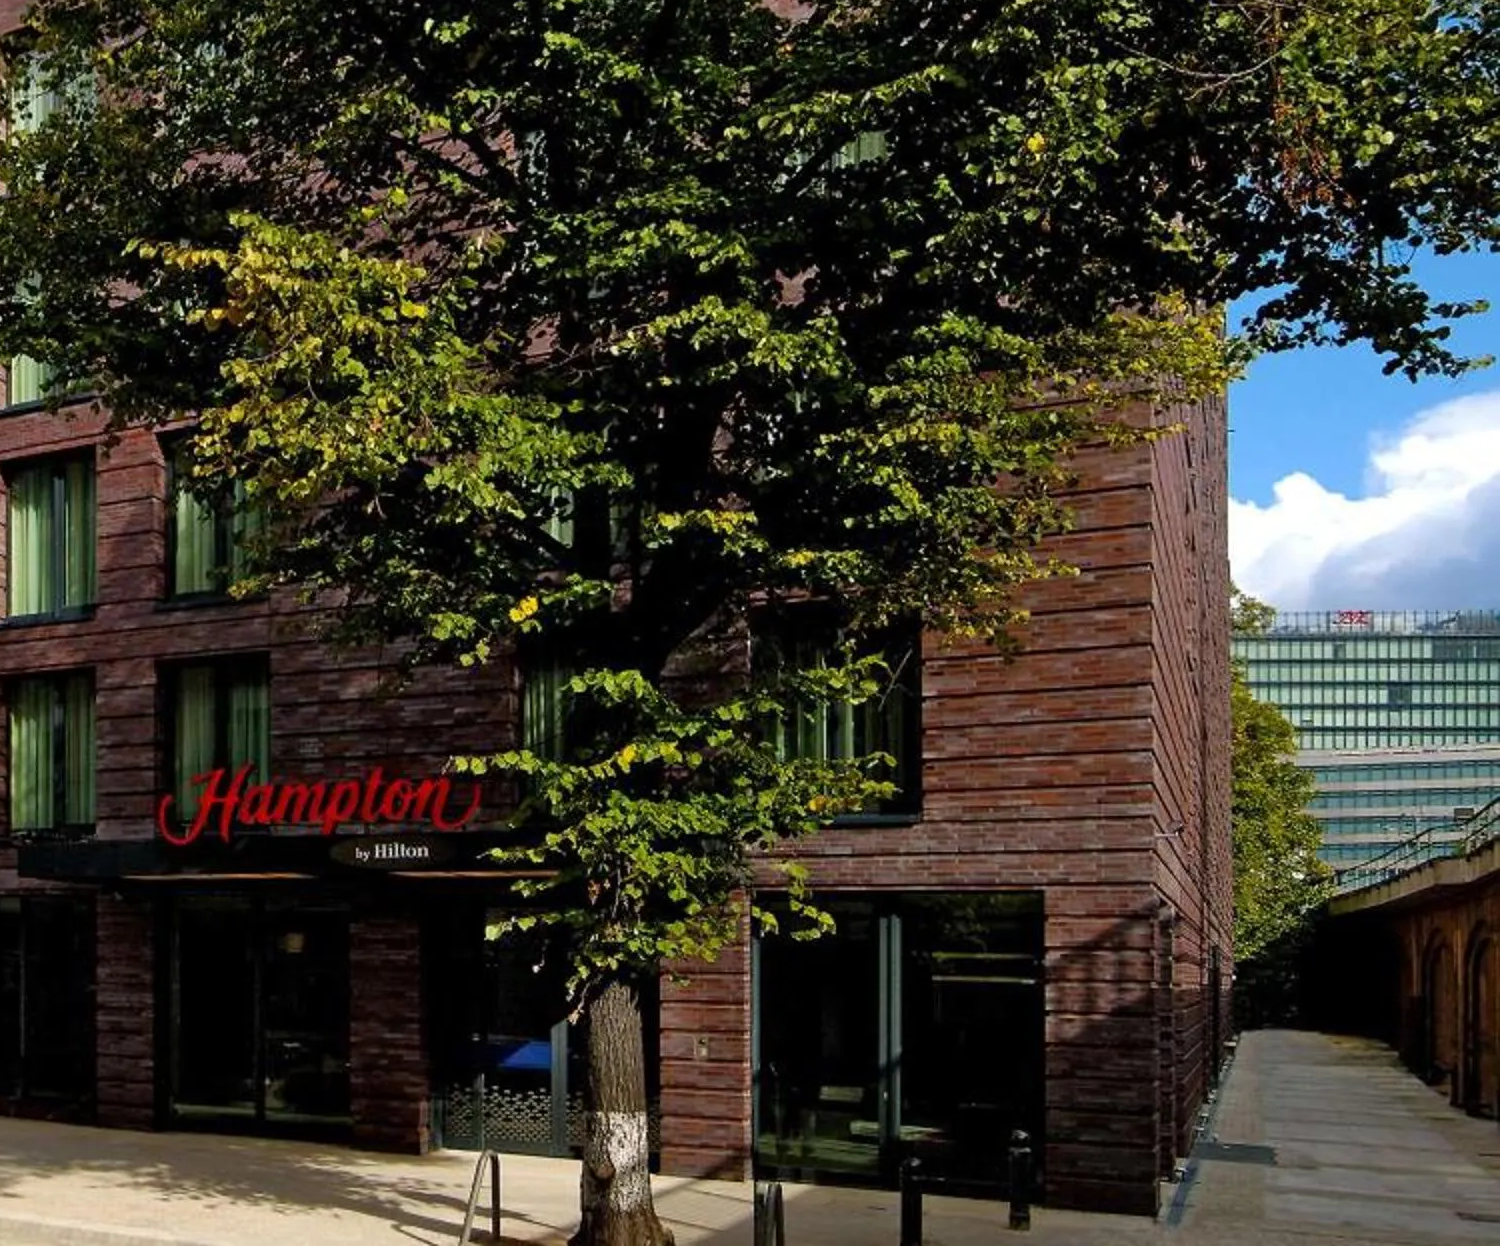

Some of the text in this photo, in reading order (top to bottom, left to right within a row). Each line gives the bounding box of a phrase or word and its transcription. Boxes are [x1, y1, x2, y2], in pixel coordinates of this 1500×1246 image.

[158, 763, 481, 846] Hampton
[355, 841, 429, 863] by Hilton
